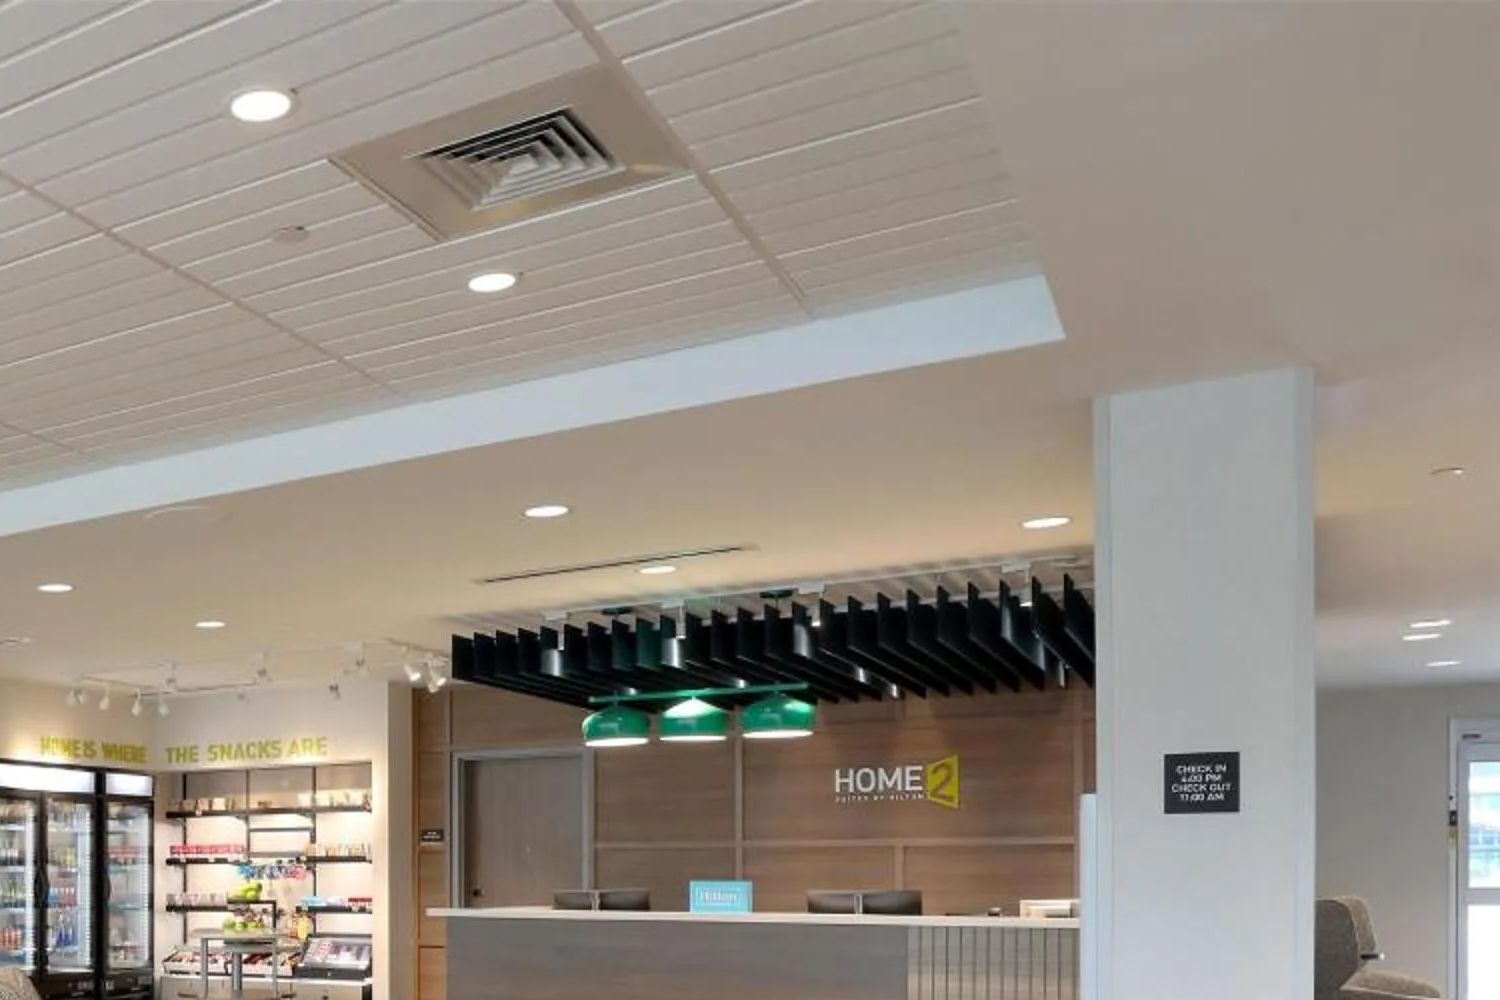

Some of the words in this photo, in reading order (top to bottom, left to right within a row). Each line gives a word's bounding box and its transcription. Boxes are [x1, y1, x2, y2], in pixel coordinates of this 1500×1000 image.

[101, 741, 147, 764] WHERE
[165, 745, 199, 763] THE
[207, 739, 282, 761] SNACKS
[285, 736, 327, 756] ARE
[1176, 765, 1213, 774] CHECK
[1215, 764, 1227, 773] IN
[1205, 773, 1222, 782] PM
[1171, 784, 1207, 793] CHECK
[1209, 783, 1232, 791] OUT
[1207, 793, 1225, 801] AM
